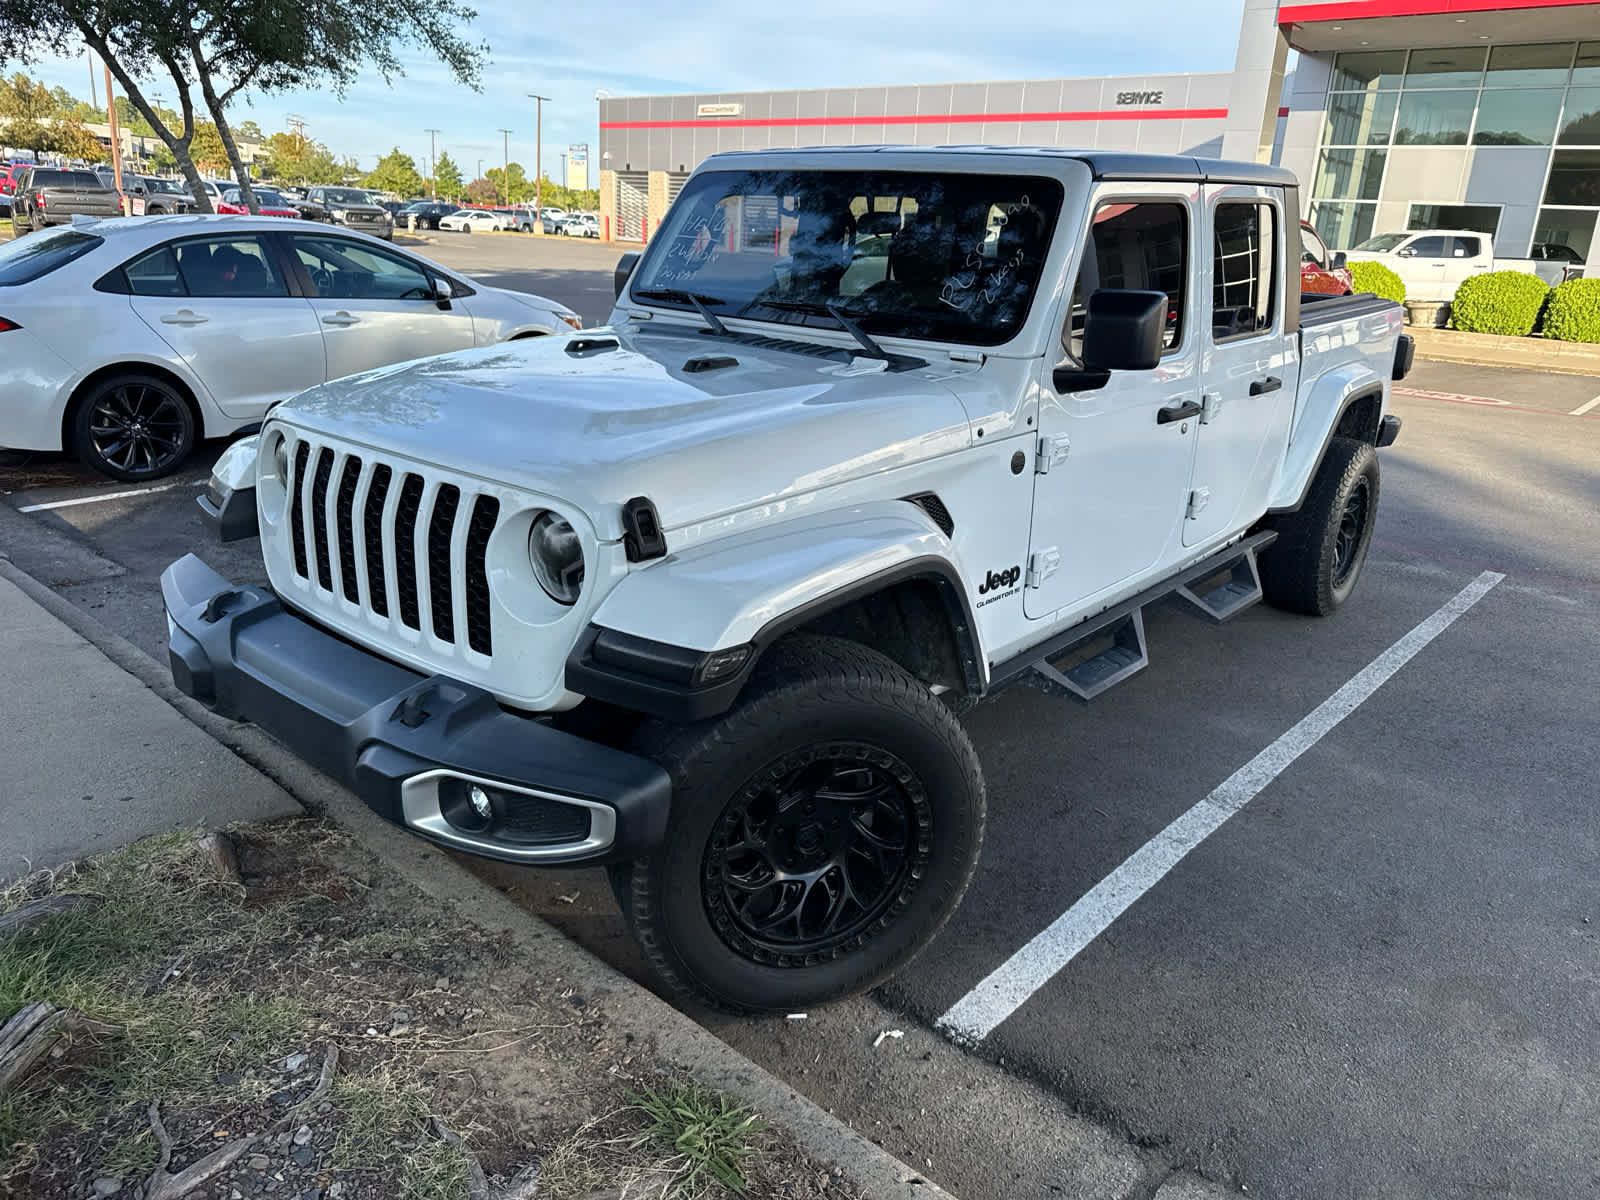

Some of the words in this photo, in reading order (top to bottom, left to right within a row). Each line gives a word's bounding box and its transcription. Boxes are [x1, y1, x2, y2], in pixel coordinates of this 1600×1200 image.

[1116, 91, 1163, 104] SERVICE
[979, 565, 1020, 594] Jeep
[976, 589, 1014, 608] GLADIATOR
